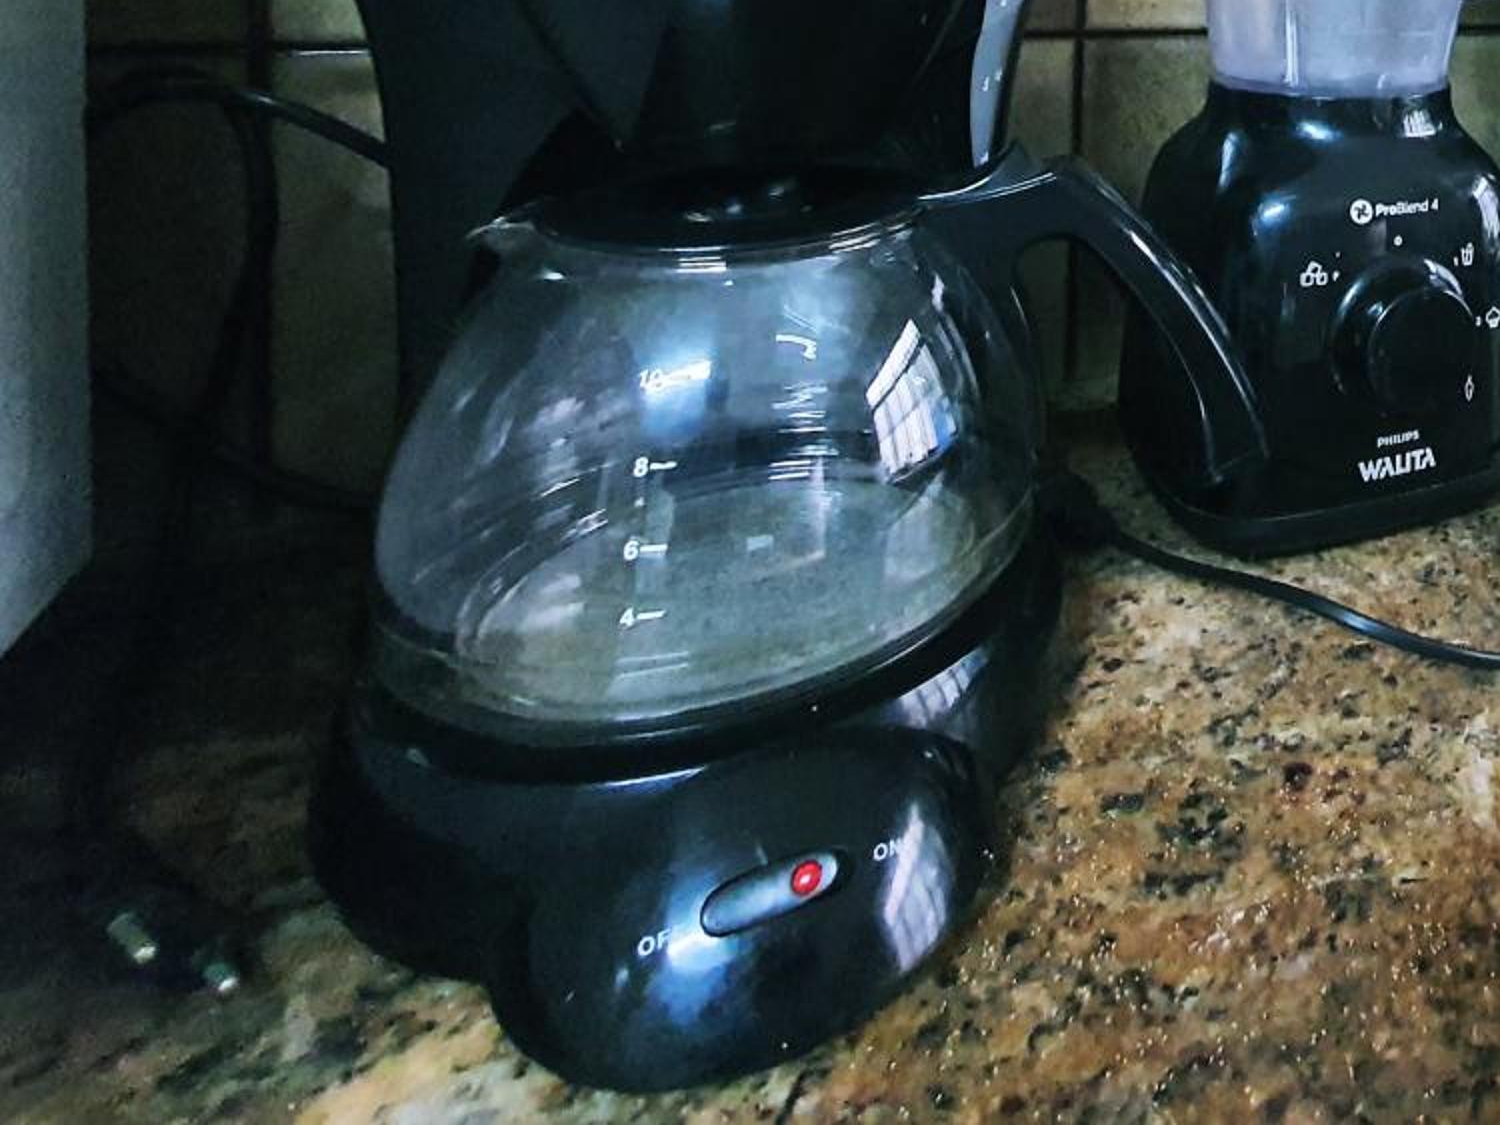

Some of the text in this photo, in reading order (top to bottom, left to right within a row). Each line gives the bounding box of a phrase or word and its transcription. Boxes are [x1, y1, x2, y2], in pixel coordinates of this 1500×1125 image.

[1375, 198, 1439, 217] ProBlend 4
[1377, 429, 1420, 448] PHILIPS
[1358, 446, 1437, 483] WALITA
